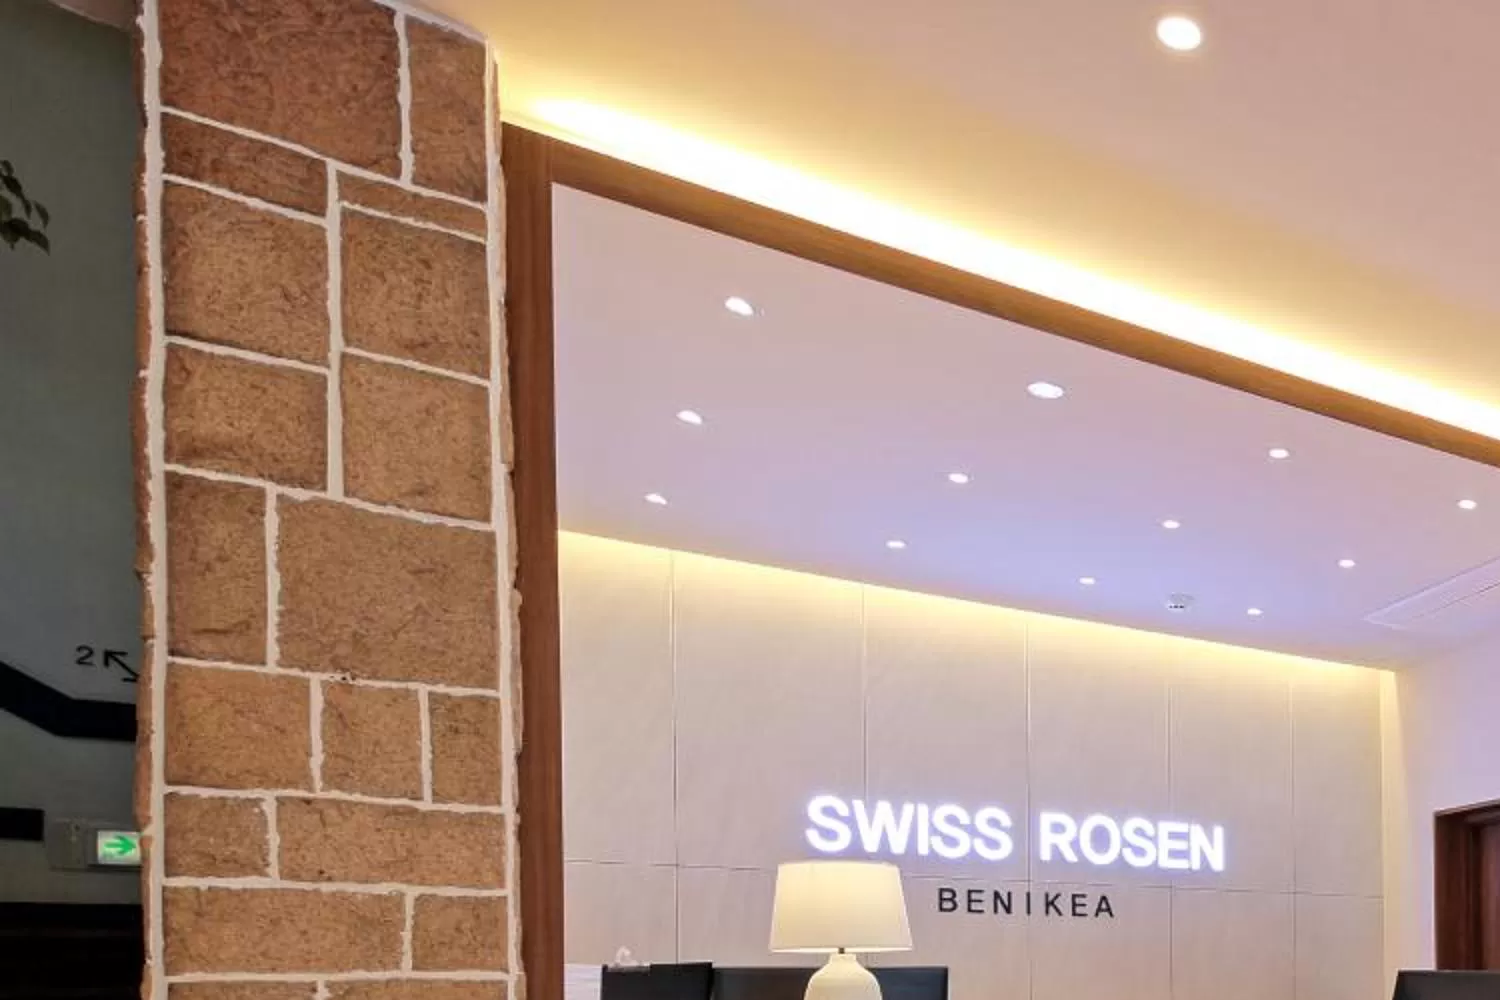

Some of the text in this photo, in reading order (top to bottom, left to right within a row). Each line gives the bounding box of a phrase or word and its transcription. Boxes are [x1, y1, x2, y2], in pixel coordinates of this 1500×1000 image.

[75, 645, 95, 666] 2
[805, 795, 1225, 872] SWISS ROSEN
[937, 886, 1116, 919] BENIKEA
